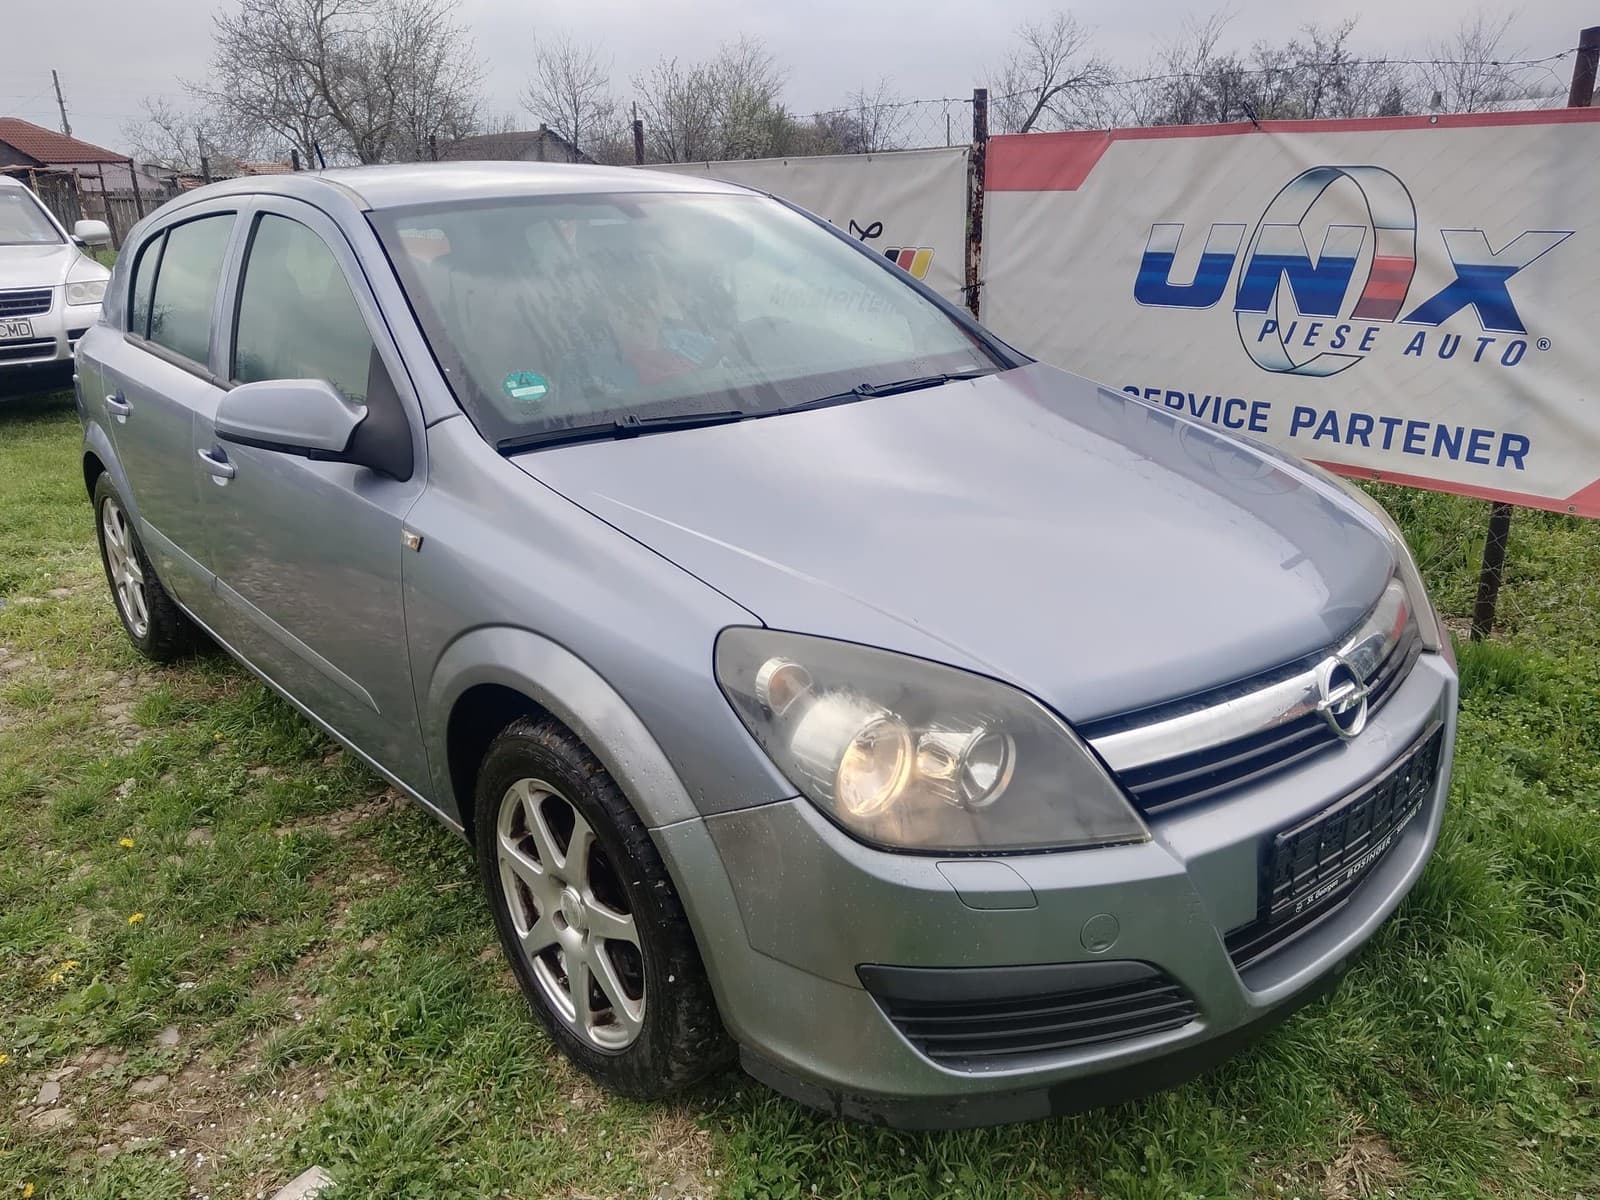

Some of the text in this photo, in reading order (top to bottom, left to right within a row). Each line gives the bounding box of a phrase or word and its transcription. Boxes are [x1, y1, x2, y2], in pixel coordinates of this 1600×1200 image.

[1134, 223, 1576, 335] UNIX
[1257, 318, 1381, 352] PIESE
[1403, 330, 1529, 367] AUTO
[1289, 405, 1531, 471] PARTENER
